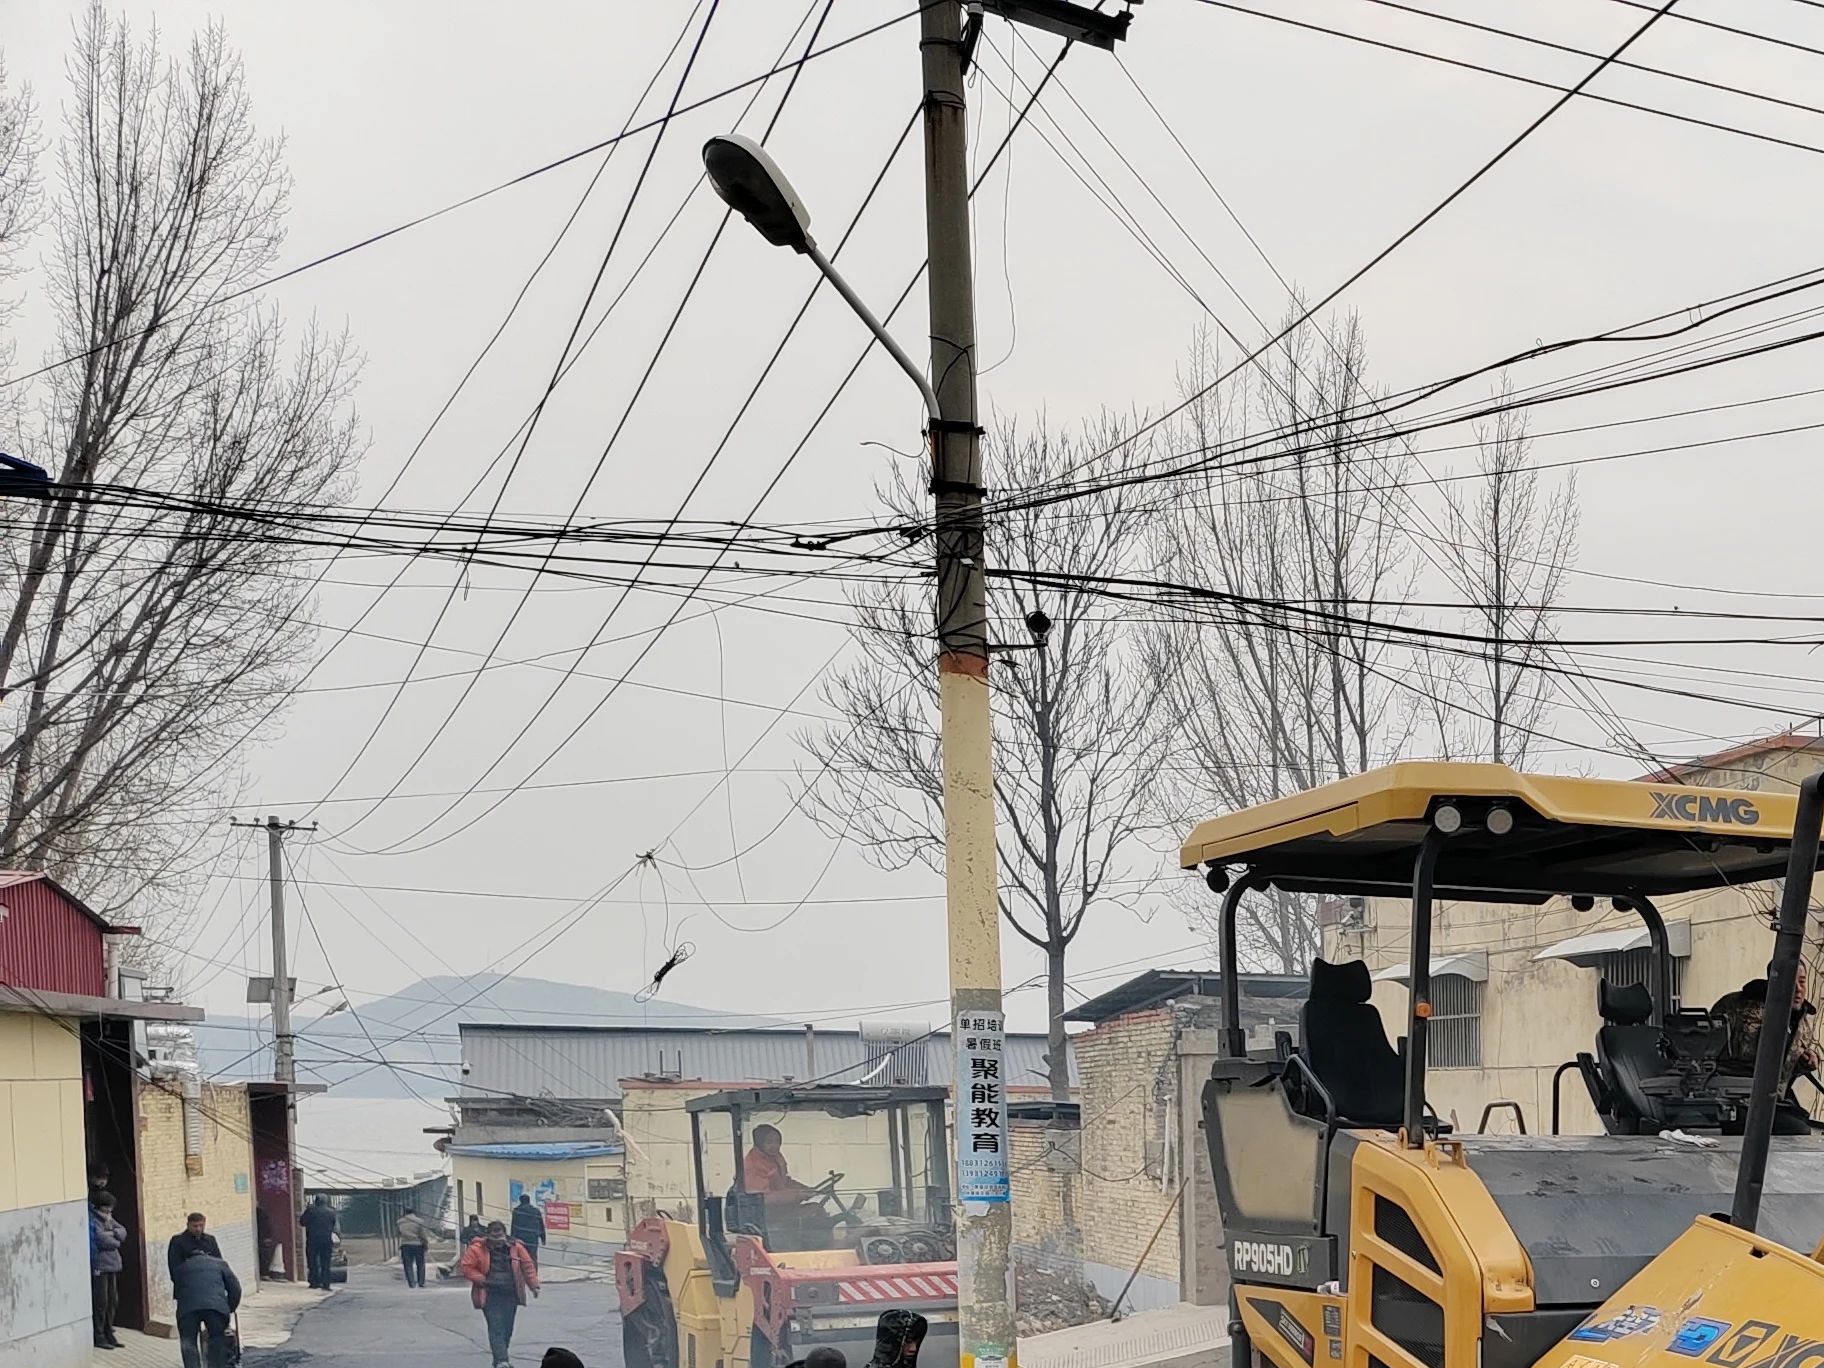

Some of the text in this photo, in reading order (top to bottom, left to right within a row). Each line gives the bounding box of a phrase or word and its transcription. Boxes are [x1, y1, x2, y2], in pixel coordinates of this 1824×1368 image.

[1649, 791, 1760, 826] XCMG
[971, 1058, 999, 1153] 聚能教育
[1233, 1240, 1293, 1276] RP905HD
